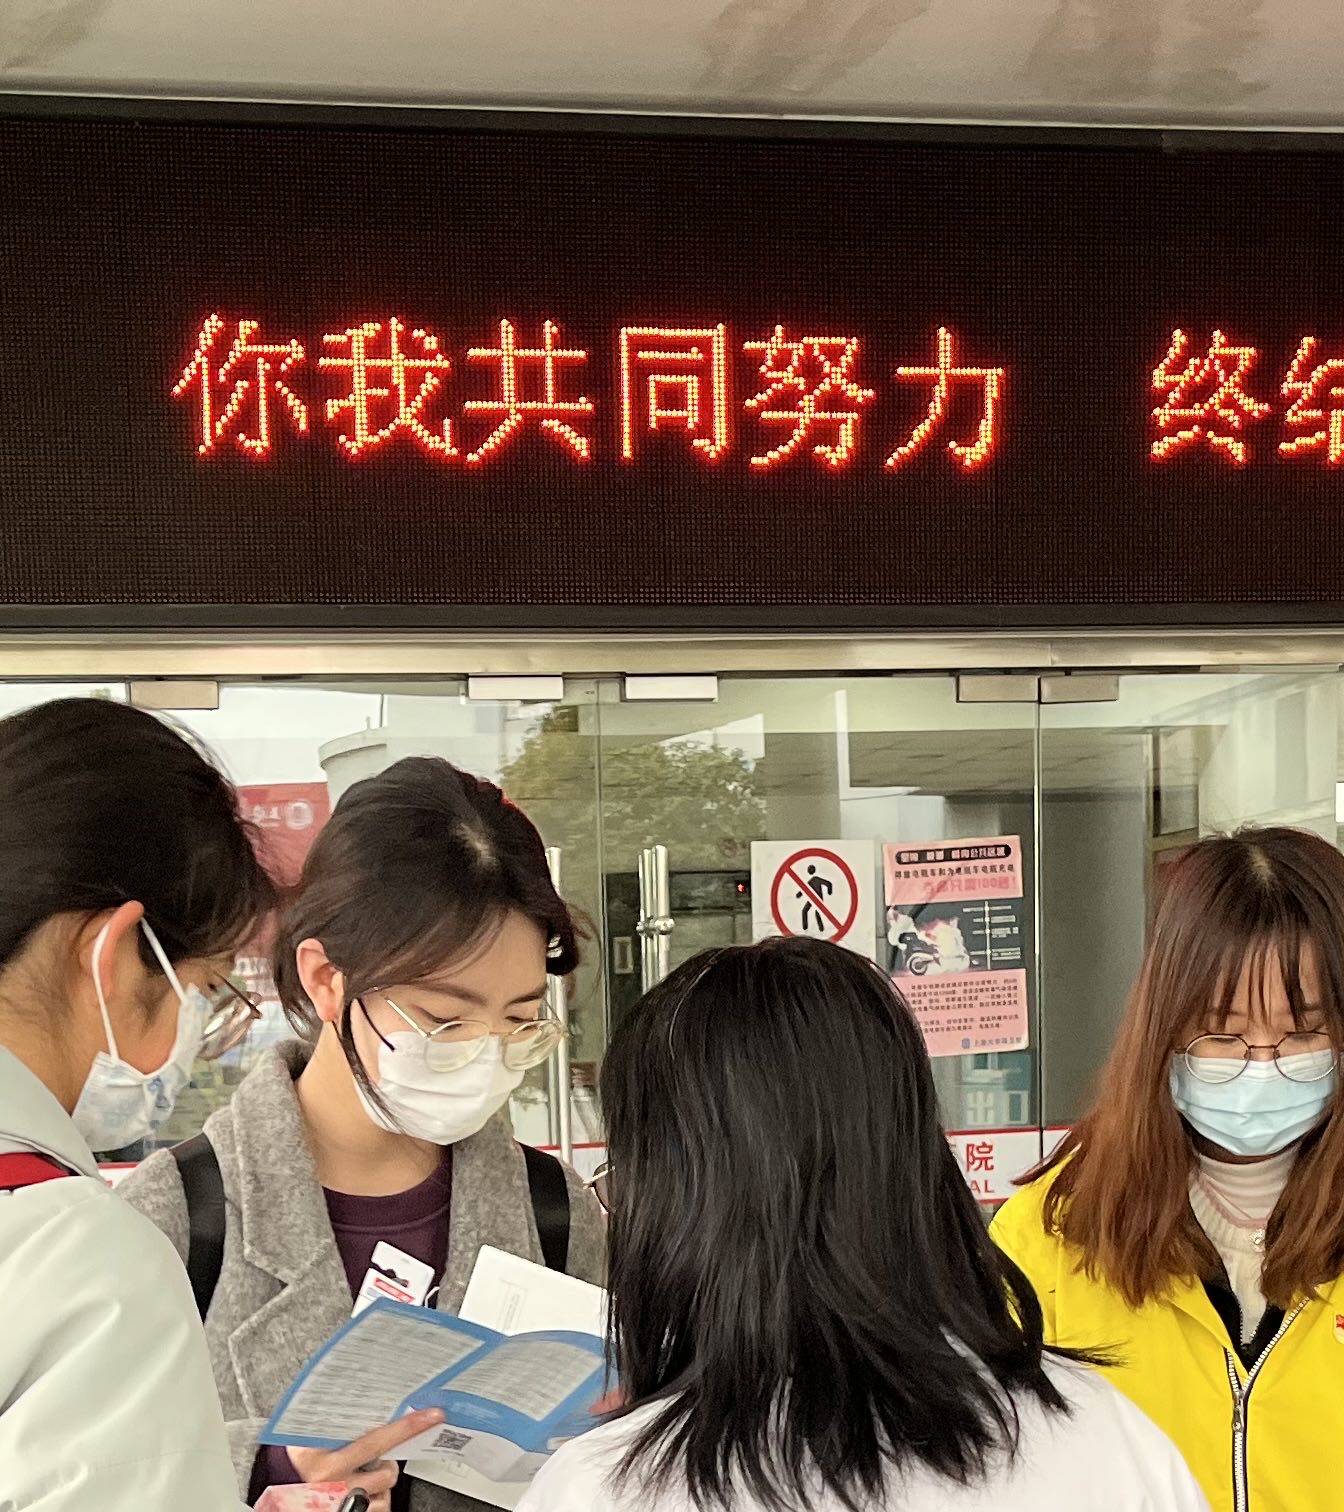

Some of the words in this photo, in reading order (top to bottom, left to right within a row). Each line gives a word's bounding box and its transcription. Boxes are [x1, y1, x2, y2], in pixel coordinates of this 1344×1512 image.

[172, 312, 1006, 473] 你我共同努力
